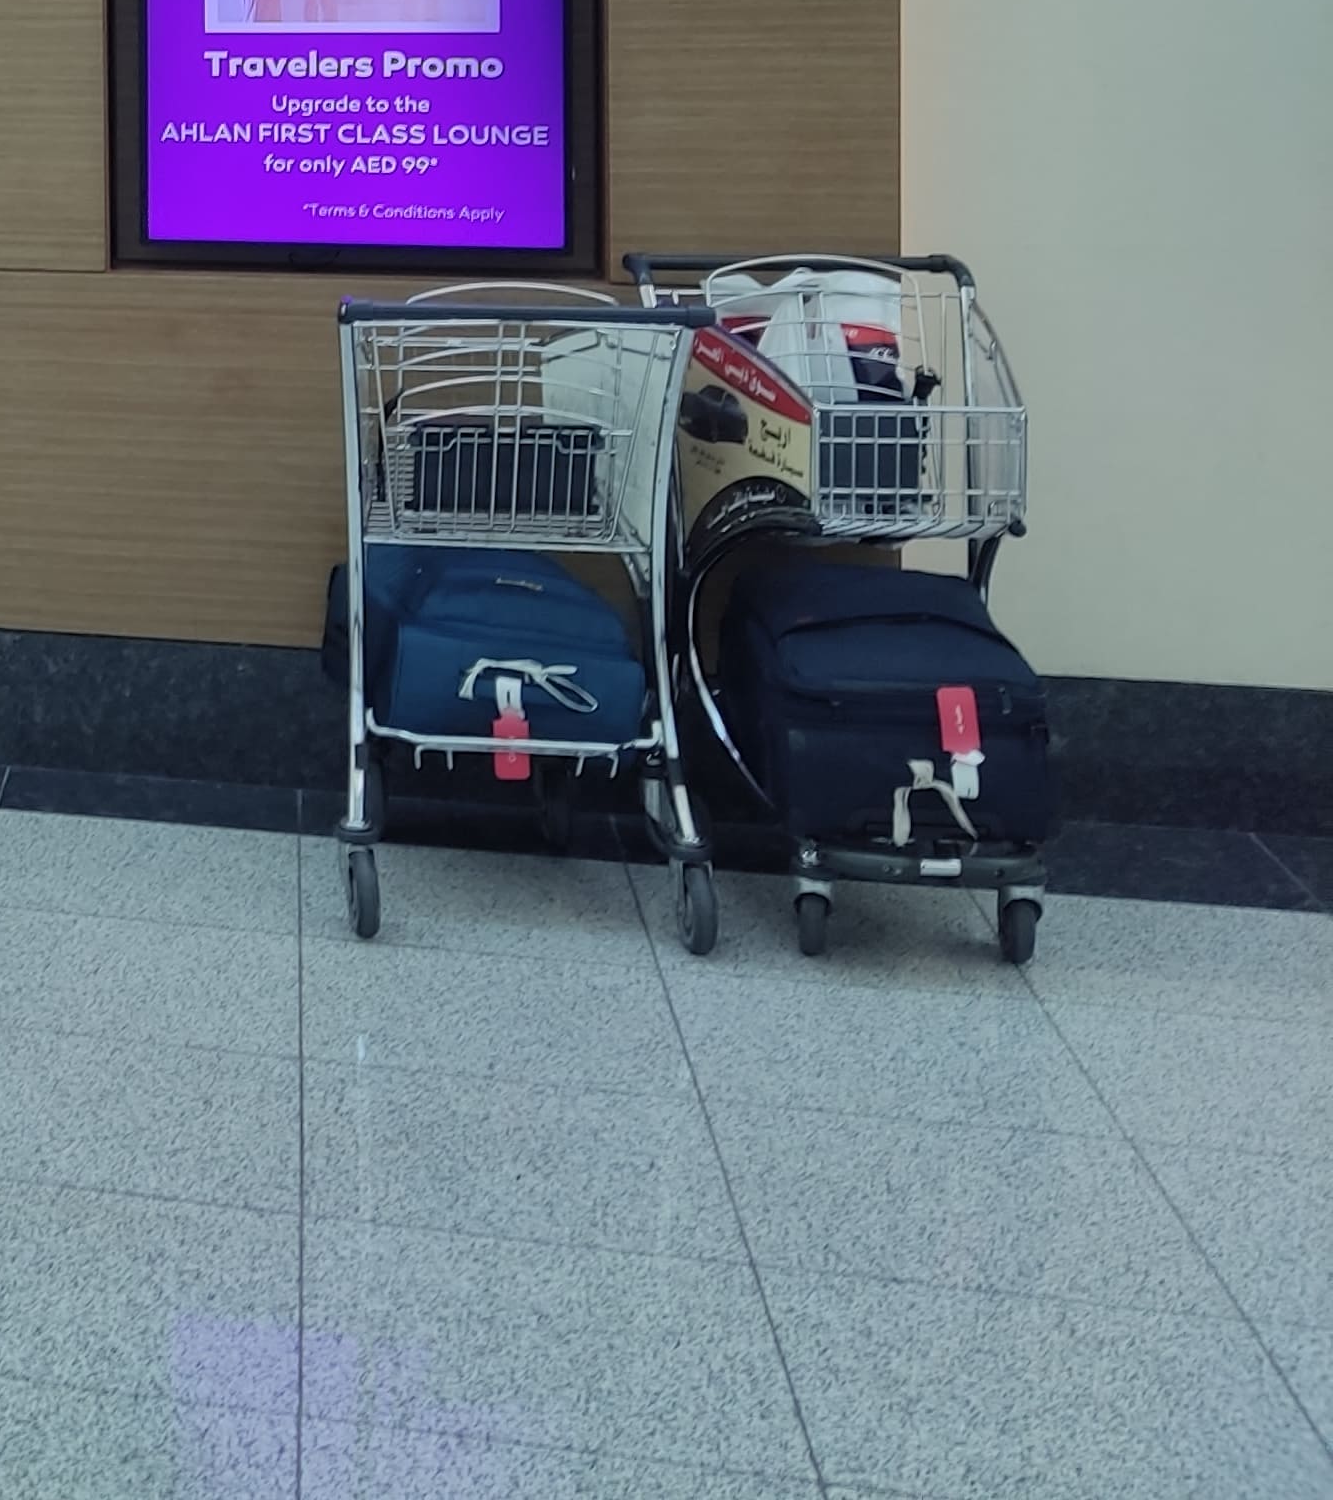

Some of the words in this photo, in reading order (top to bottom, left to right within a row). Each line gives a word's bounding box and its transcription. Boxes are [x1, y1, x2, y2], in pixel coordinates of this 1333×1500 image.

[204, 50, 374, 79] Travelers
[383, 51, 504, 79] Promo
[271, 94, 361, 117] Upgrade
[366, 95, 389, 113] to
[393, 94, 430, 113] the
[160, 122, 251, 143] AHLAN
[258, 122, 331, 144] FIRST
[337, 122, 426, 145] CLASS
[432, 124, 550, 146] LOUNGE
[263, 153, 294, 173] for
[299, 153, 346, 177] only
[350, 155, 396, 174] AED
[358, 204, 369, 219] &
[372, 203, 455, 220] Conditions
[459, 205, 505, 223] Apply
